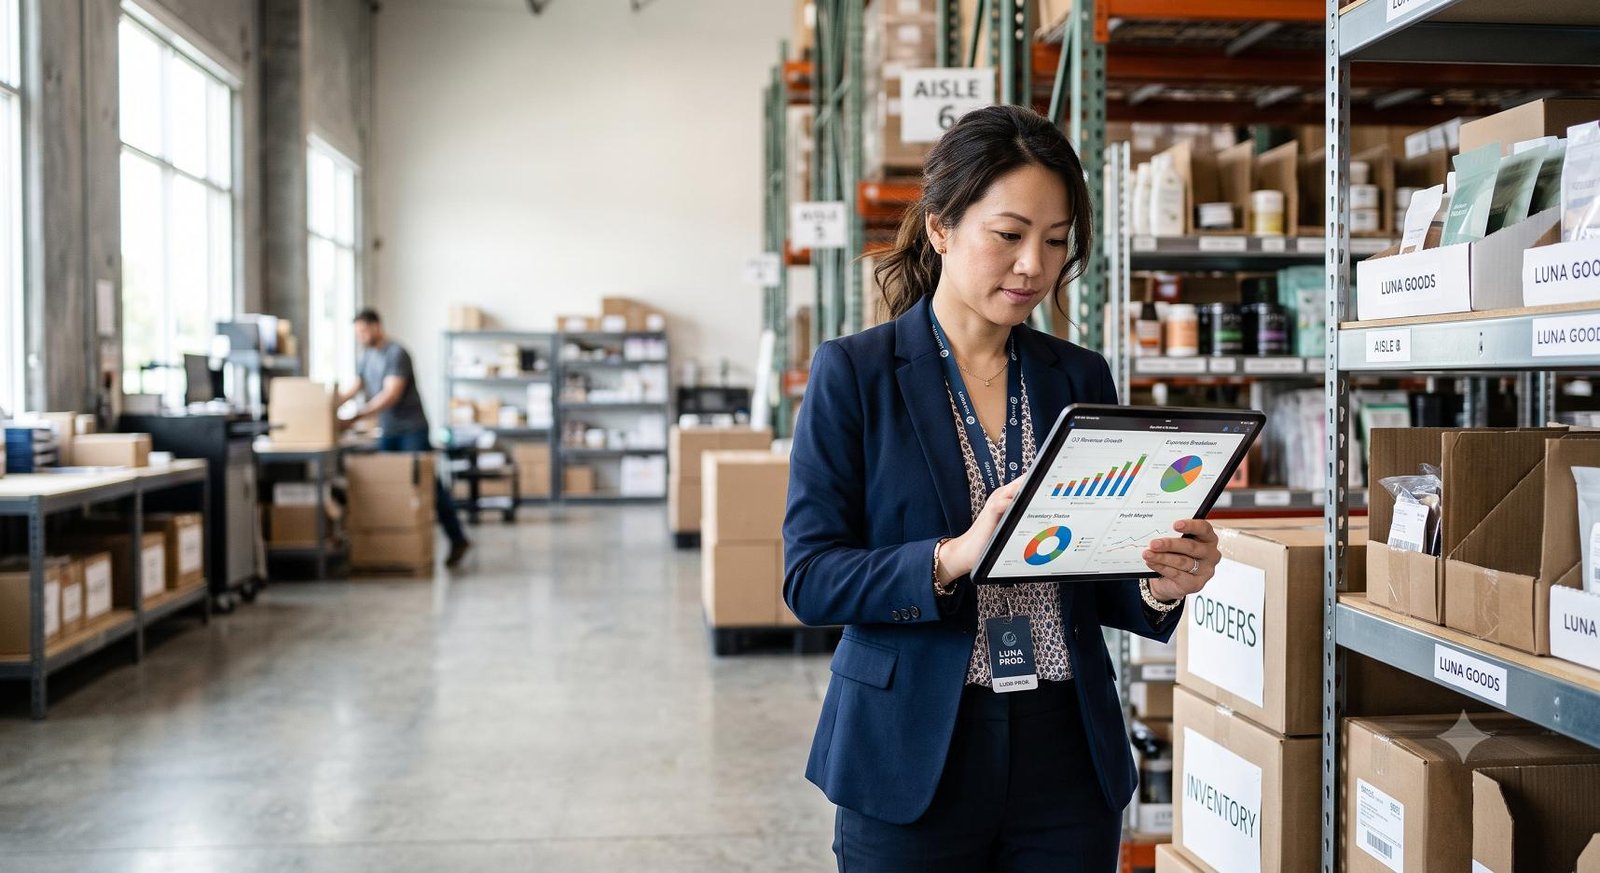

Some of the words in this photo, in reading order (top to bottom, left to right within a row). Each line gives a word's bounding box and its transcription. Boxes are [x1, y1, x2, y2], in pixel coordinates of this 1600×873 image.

[913, 79, 979, 99] AISLE
[938, 104, 956, 131] 6
[1381, 279, 1403, 295] LUNA
[1404, 273, 1436, 292] GOODS
[1535, 264, 1568, 284] LUNA
[1374, 340, 1394, 353] AISLE
[1537, 329, 1566, 345] LUNA
[1194, 594, 1257, 648] ORDERS
[1564, 613, 1598, 638] LUNA
[999, 649, 1023, 657] LUNA
[999, 657, 1025, 665] PROD.
[1440, 656, 1464, 678] LUNA
[1465, 666, 1500, 692] GOODS
[1187, 773, 1256, 837] INVENTORY
